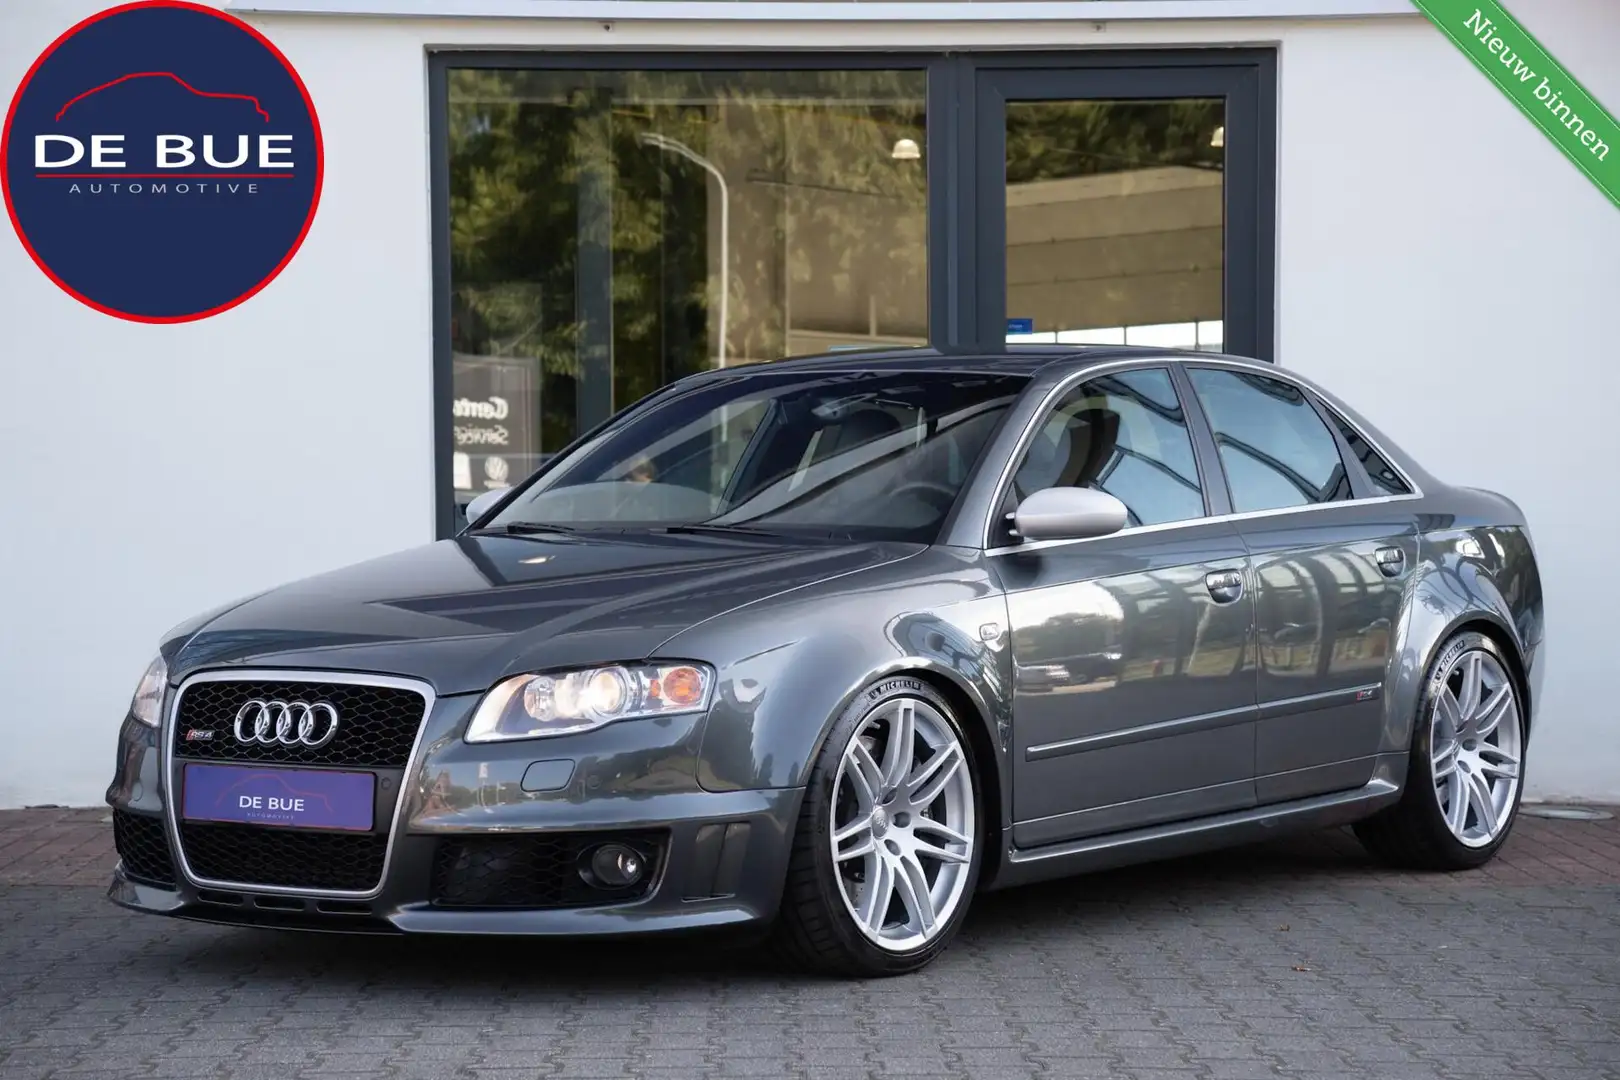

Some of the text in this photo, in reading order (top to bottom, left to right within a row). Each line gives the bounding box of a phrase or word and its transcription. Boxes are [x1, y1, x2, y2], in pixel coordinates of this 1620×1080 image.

[880, 680, 921, 693] MICHELIN
[239, 795, 305, 812] DE BUE
